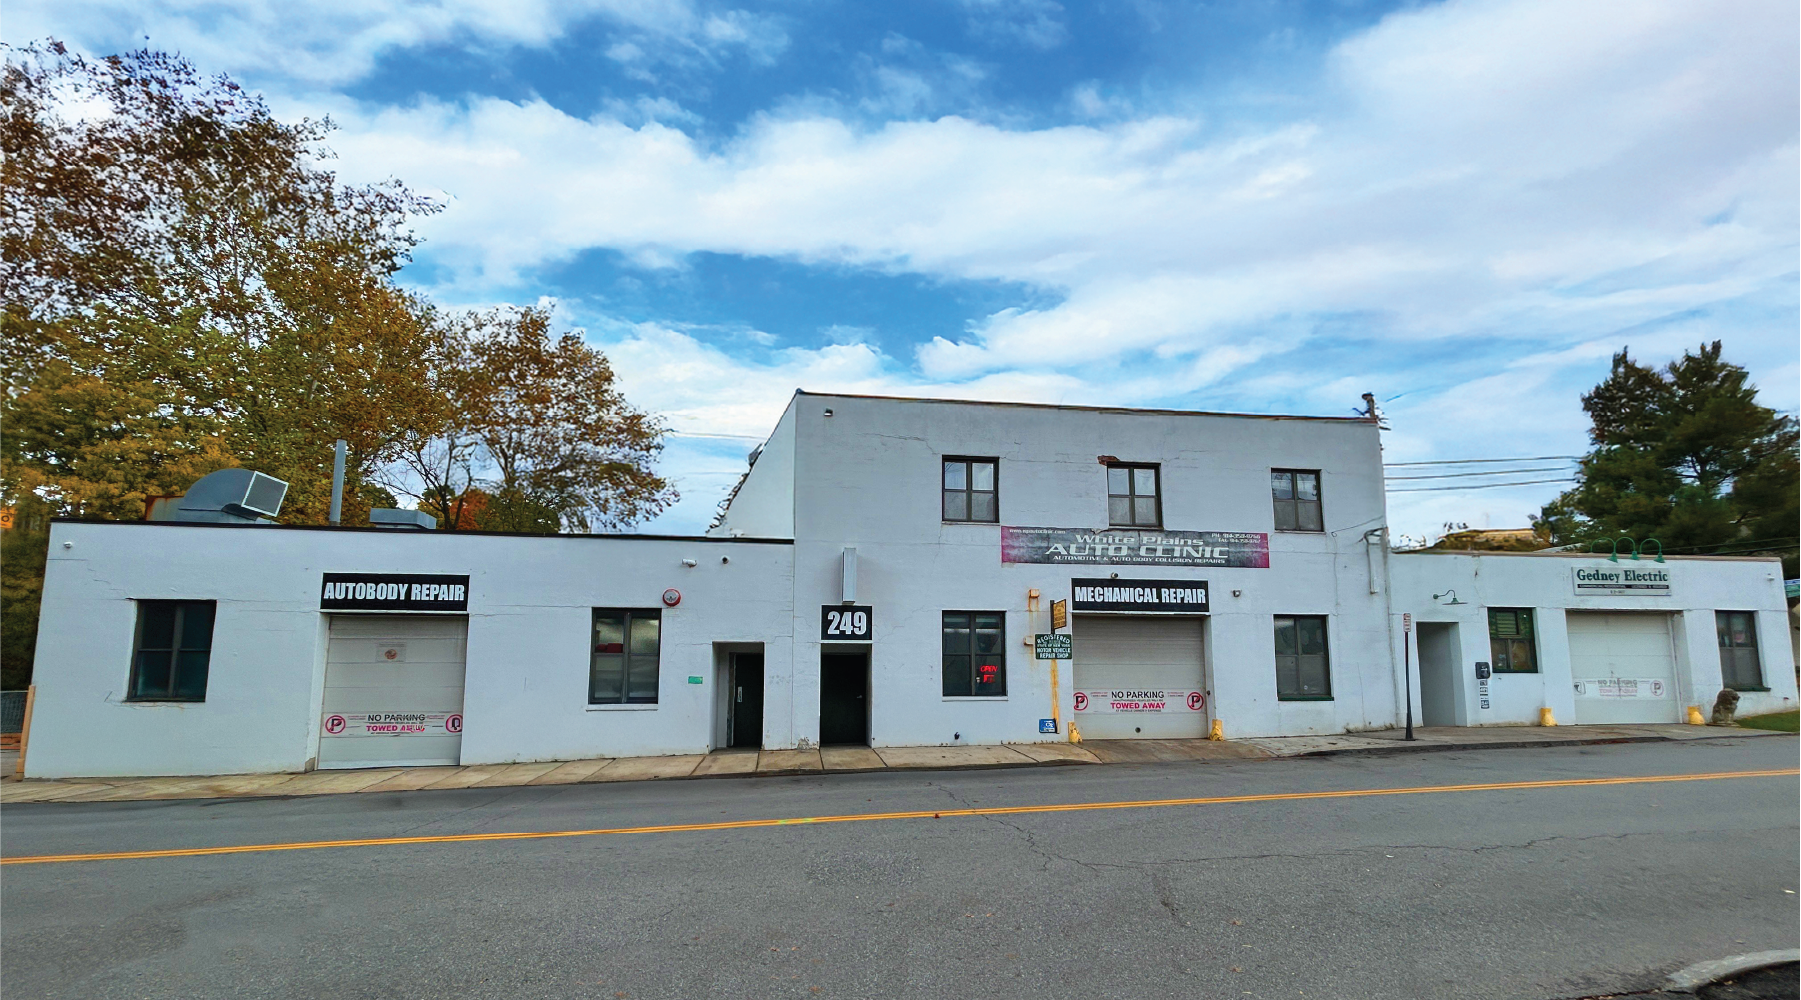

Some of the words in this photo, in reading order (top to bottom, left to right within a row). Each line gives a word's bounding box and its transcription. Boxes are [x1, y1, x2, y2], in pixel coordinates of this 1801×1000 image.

[1075, 534, 1135, 543] White
[1142, 536, 1204, 546] Plains
[1044, 543, 1128, 556] AUTO
[1139, 545, 1230, 558] CLINIC
[1577, 568, 1620, 583] Gedney
[1623, 569, 1668, 582] Electric
[323, 582, 408, 601] AUTOBODY
[411, 584, 465, 601] REPAIR
[1074, 586, 1159, 603] MECHANICAL
[1161, 588, 1206, 604] REPAIR
[827, 611, 867, 635] 249
[1037, 634, 1070, 644] REGISTERED
[1111, 691, 1124, 699] NO
[1126, 691, 1165, 699] PARKING
[367, 714, 382, 722] NO
[384, 714, 426, 722] PARKING
